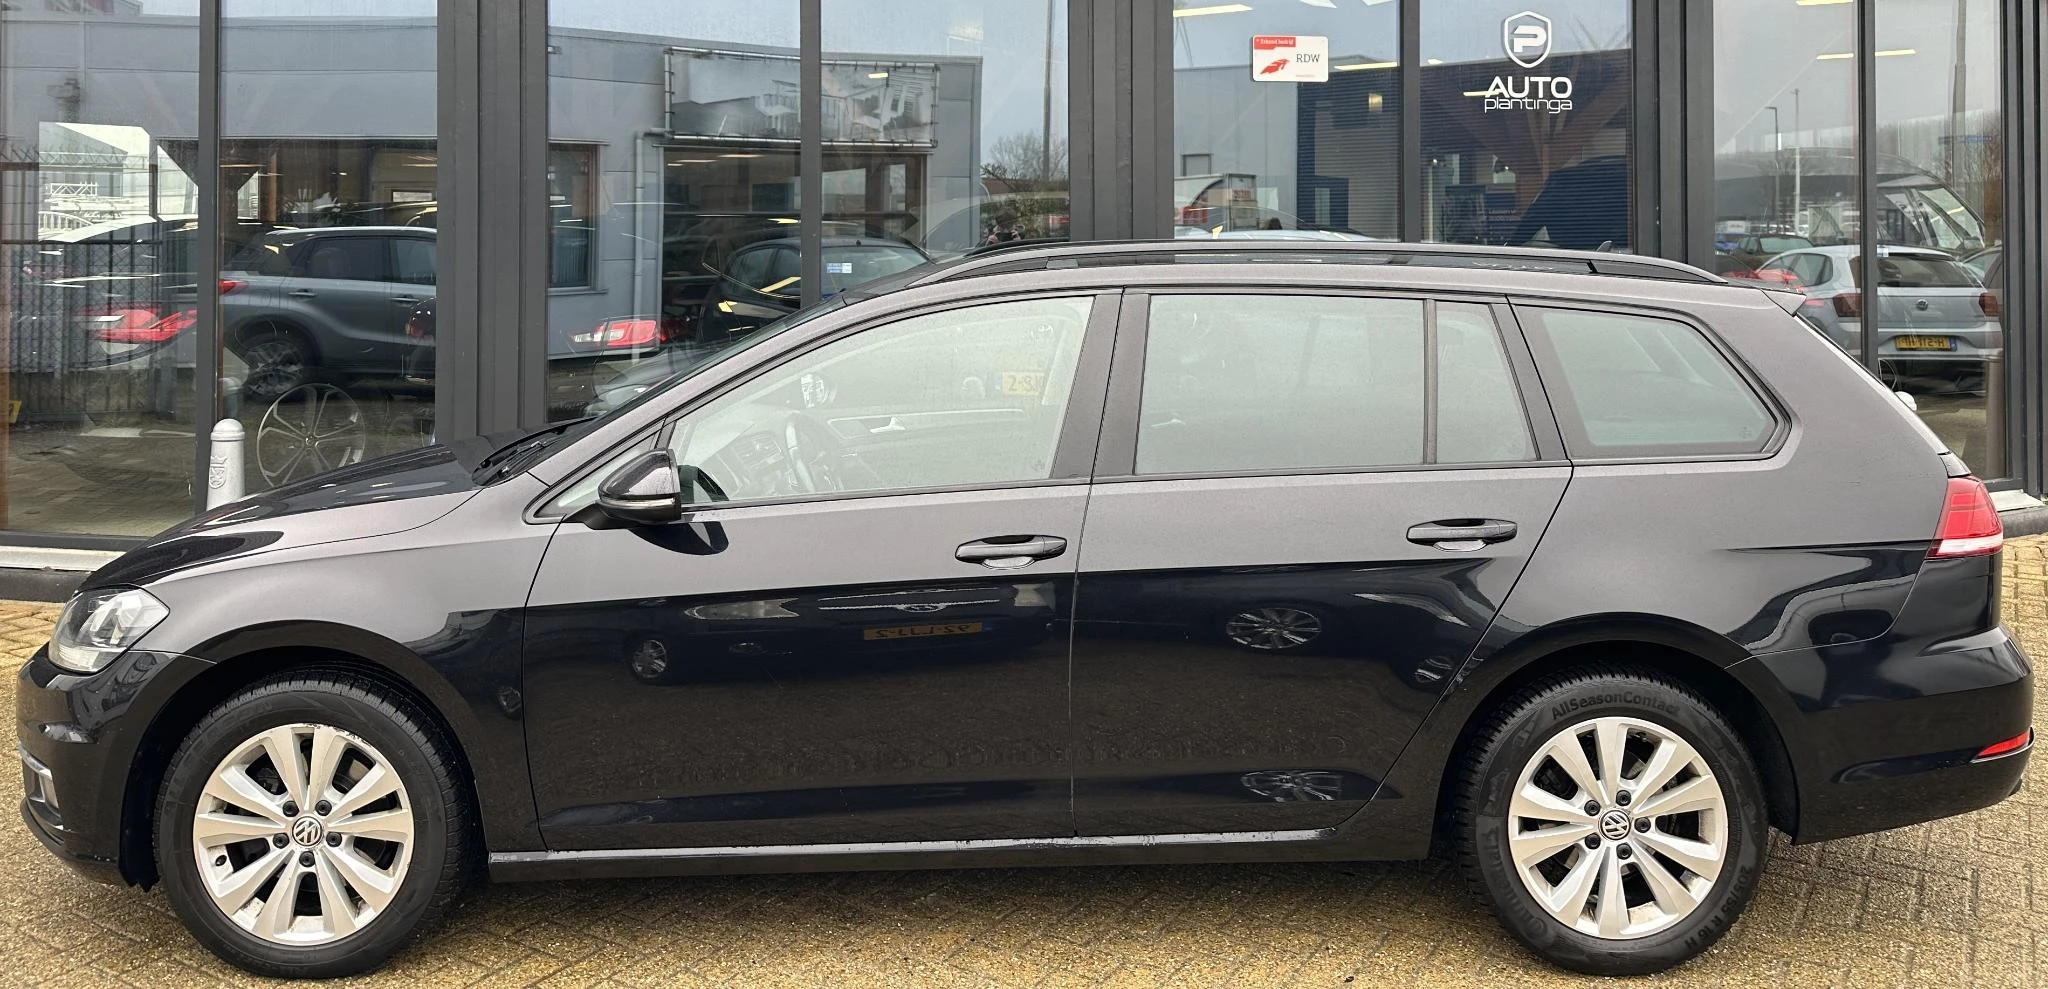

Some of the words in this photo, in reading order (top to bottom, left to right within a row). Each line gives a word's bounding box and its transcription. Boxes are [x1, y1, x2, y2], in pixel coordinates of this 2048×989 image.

[1296, 53, 1320, 63] RDW
[1485, 75, 1572, 98] AUTO
[1484, 96, 1573, 114] plantinga
[1552, 691, 1680, 720] AllSeasonContact
[1711, 915, 1723, 927] R
[1697, 925, 1714, 938] 16
[1684, 937, 1698, 949] H
